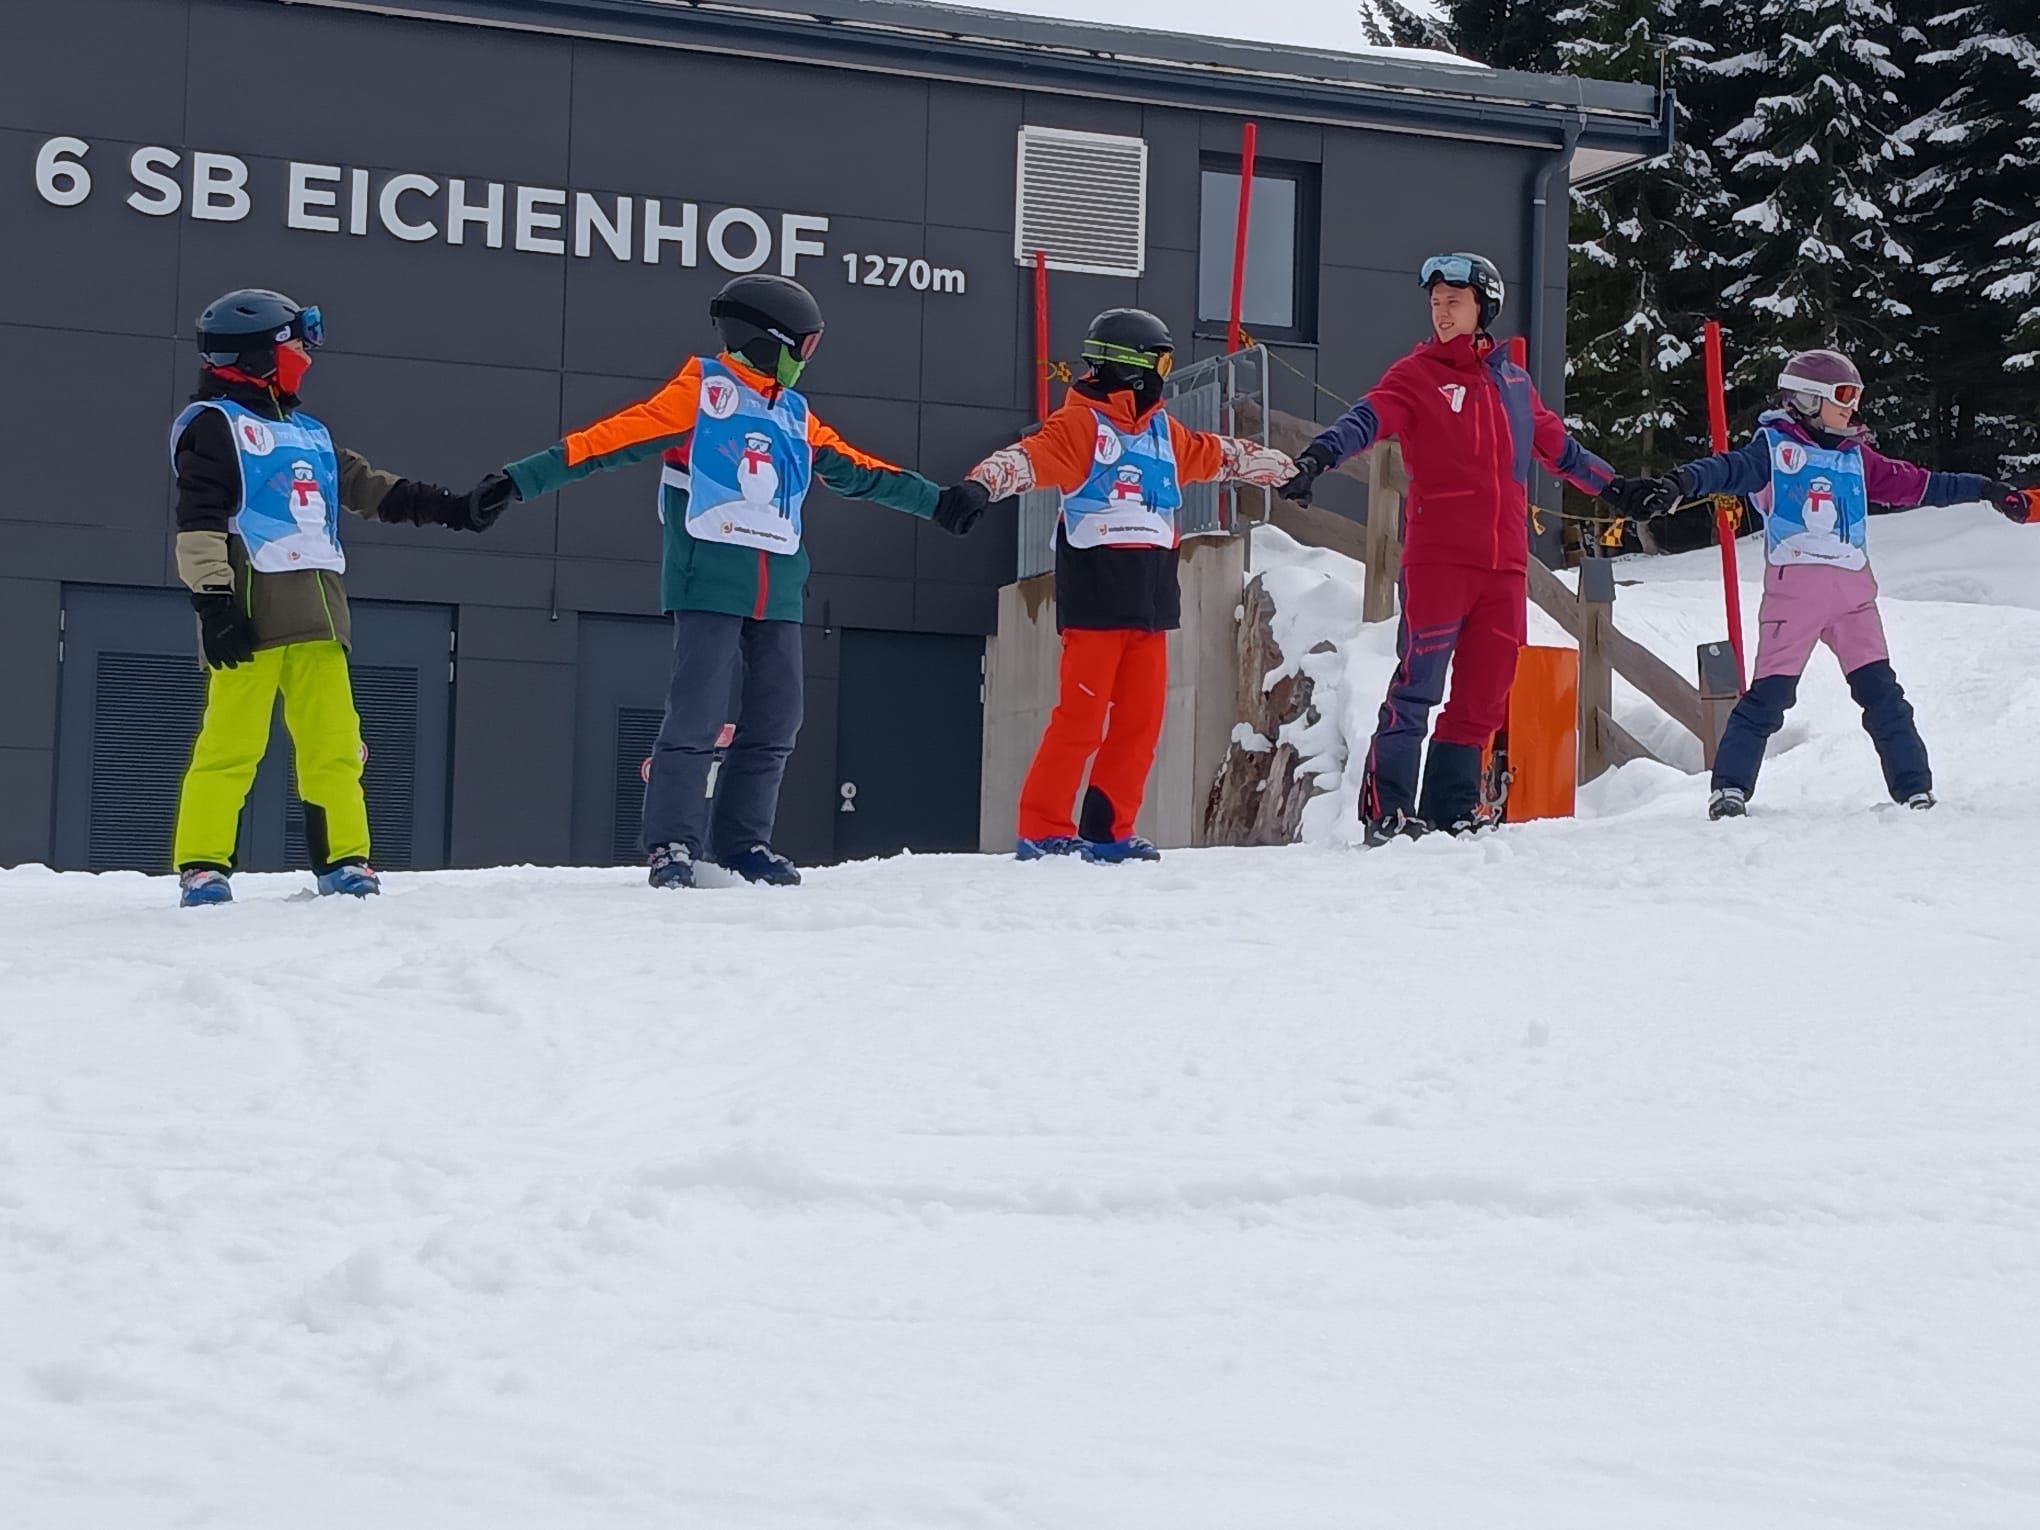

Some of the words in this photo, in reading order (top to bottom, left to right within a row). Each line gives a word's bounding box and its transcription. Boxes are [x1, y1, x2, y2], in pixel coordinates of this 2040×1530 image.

[35, 136, 91, 206] 6
[126, 146, 251, 222] SB
[287, 161, 829, 277] EICHENHOF
[842, 252, 966, 295] 1270m
